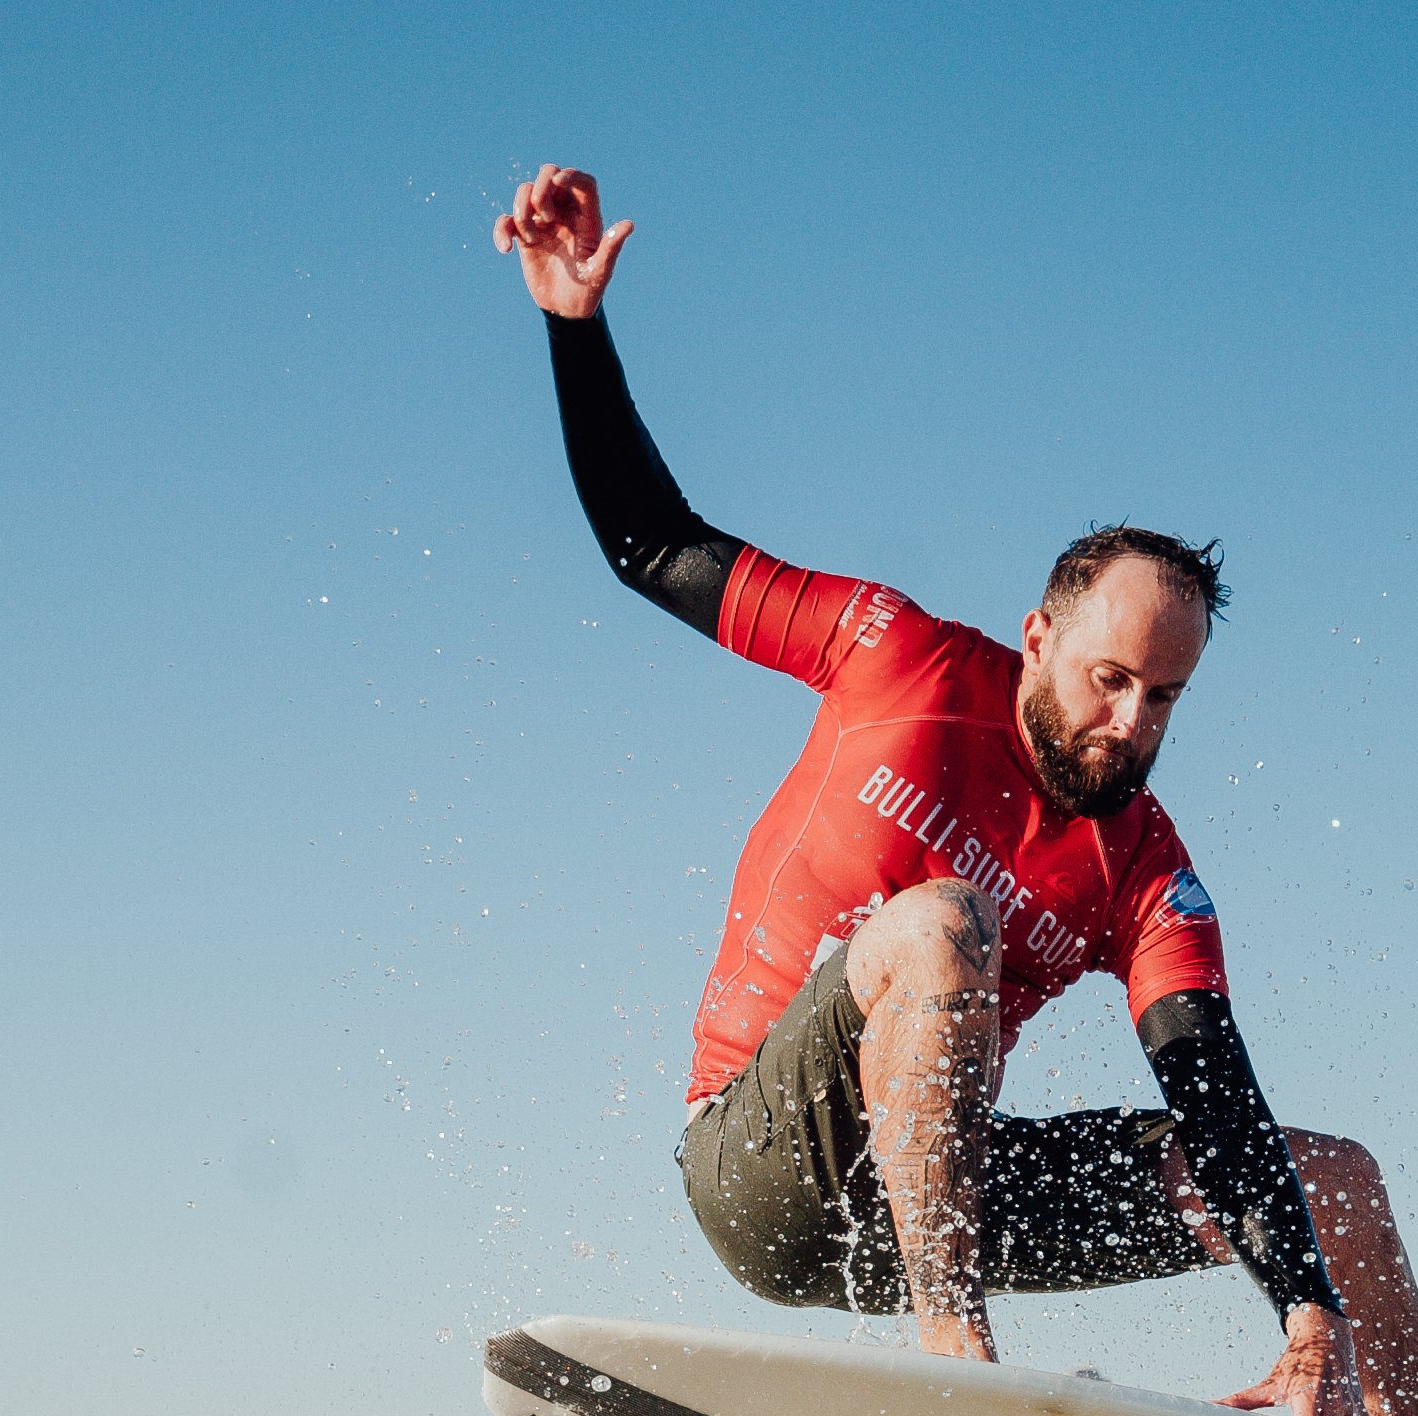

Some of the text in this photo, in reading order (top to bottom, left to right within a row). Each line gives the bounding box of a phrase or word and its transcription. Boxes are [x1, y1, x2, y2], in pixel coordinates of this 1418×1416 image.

[857, 764, 1085, 970] BULLI SURF CUP
